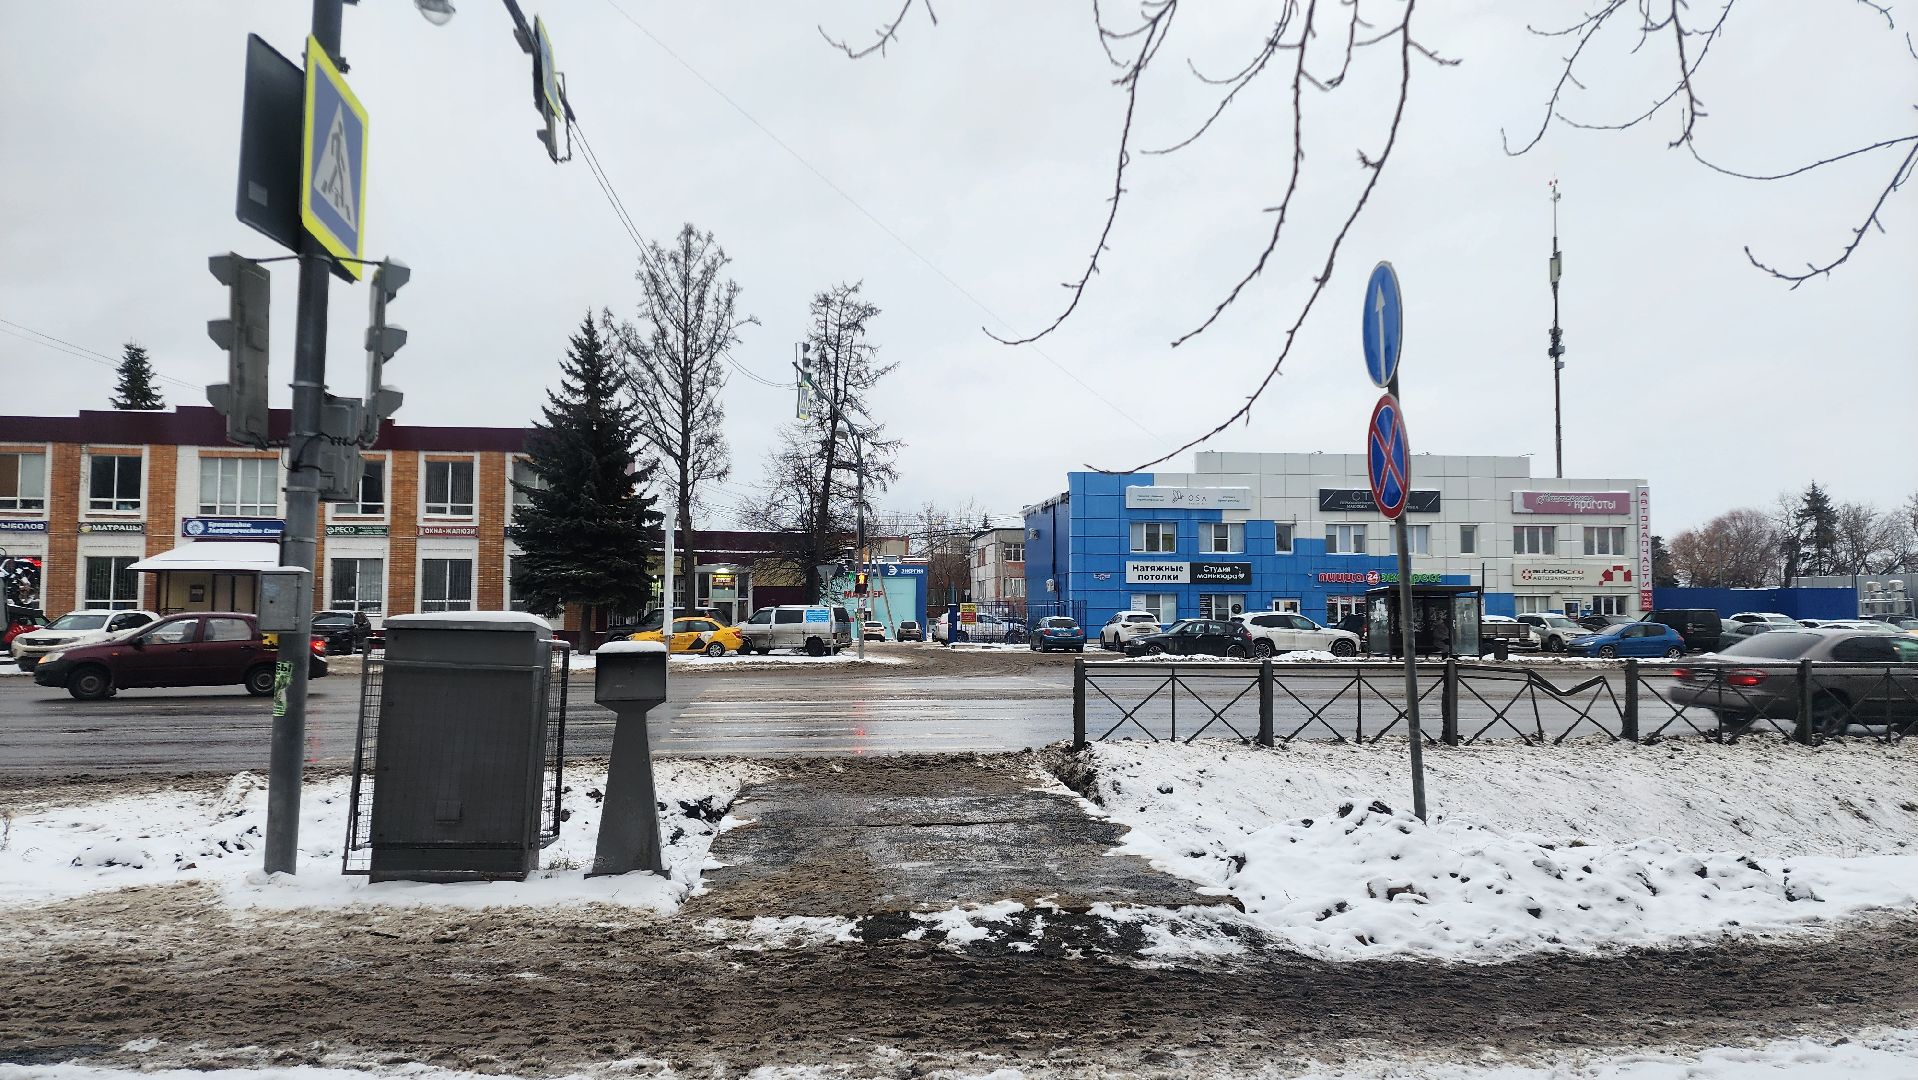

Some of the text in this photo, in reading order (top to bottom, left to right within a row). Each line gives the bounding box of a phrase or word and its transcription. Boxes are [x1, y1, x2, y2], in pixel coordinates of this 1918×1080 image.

[1640, 491, 1650, 588] АВТОЗАПЧАСТИ
[1203, 565, 1231, 574] Студия
[1137, 573, 1179, 581] потолки
